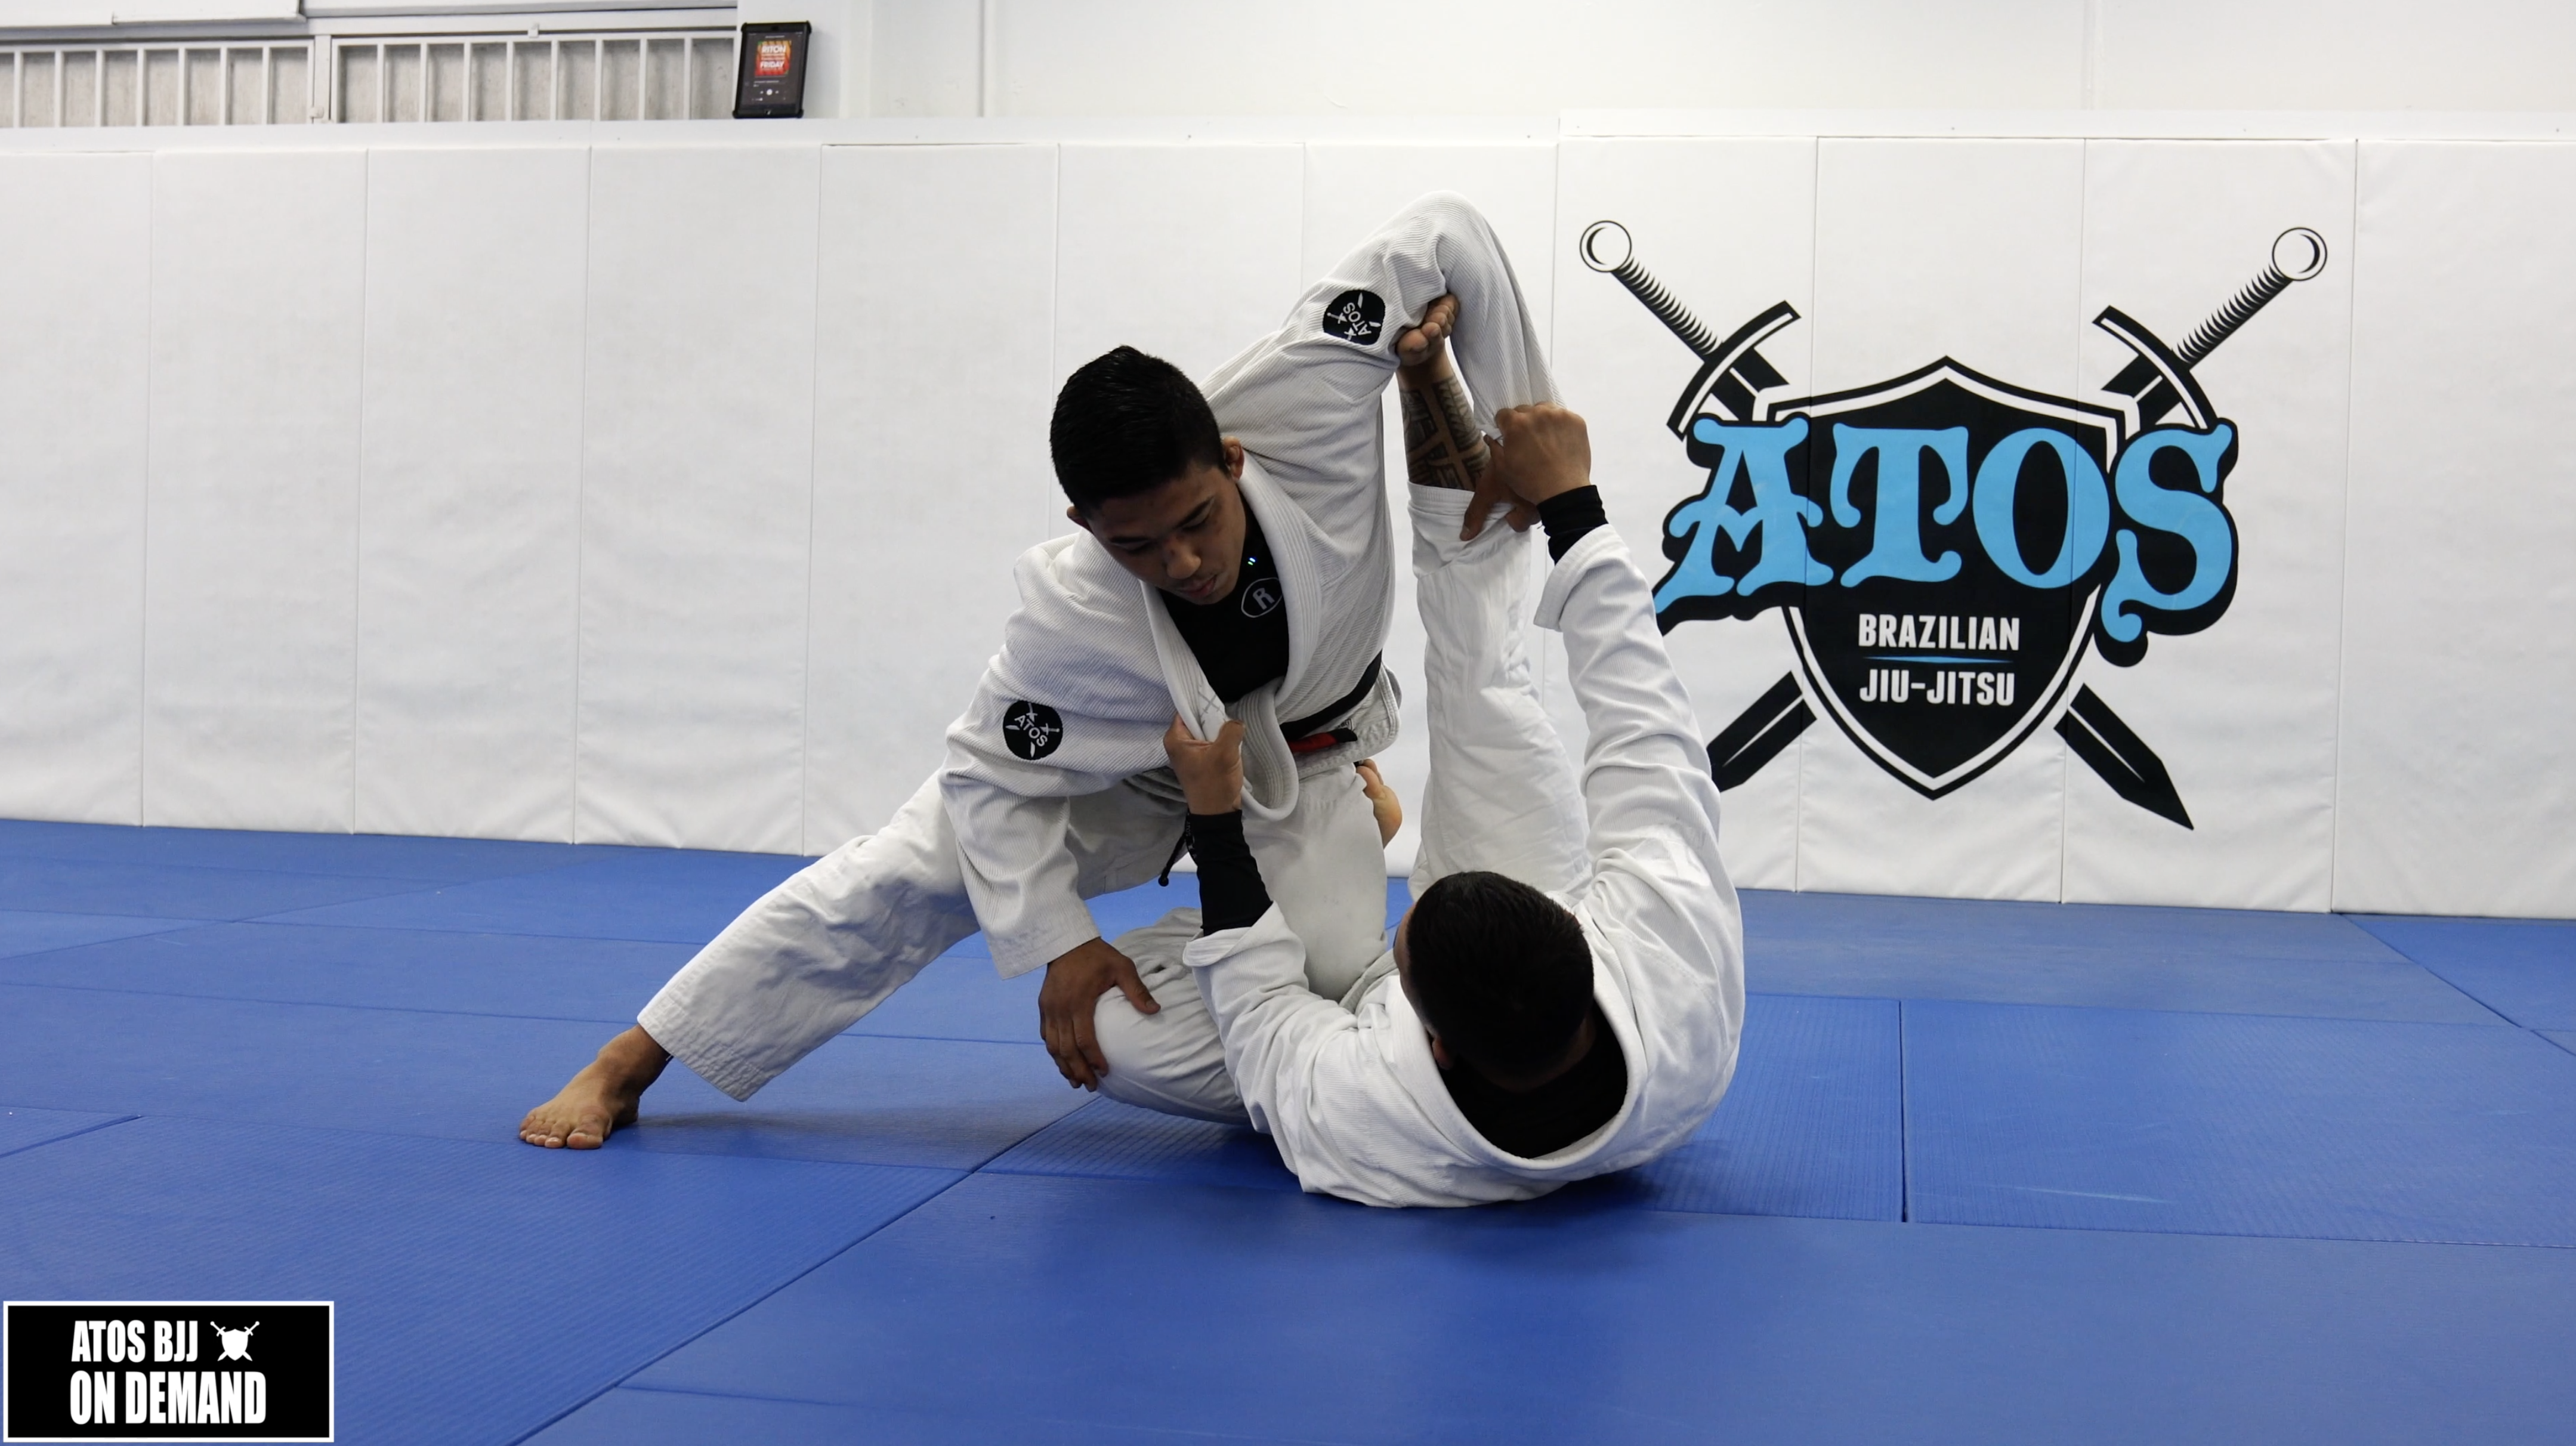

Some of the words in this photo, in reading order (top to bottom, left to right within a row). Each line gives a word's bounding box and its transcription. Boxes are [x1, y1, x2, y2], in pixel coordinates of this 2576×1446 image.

[1343, 302, 1372, 336] ATOS
[1654, 417, 2232, 642] ATOS
[1252, 588, 1275, 610] R
[1858, 614, 2019, 651] BRAZILIAN
[1859, 669, 2015, 706] JIU-JITSU
[1014, 715, 1048, 747] ATOS
